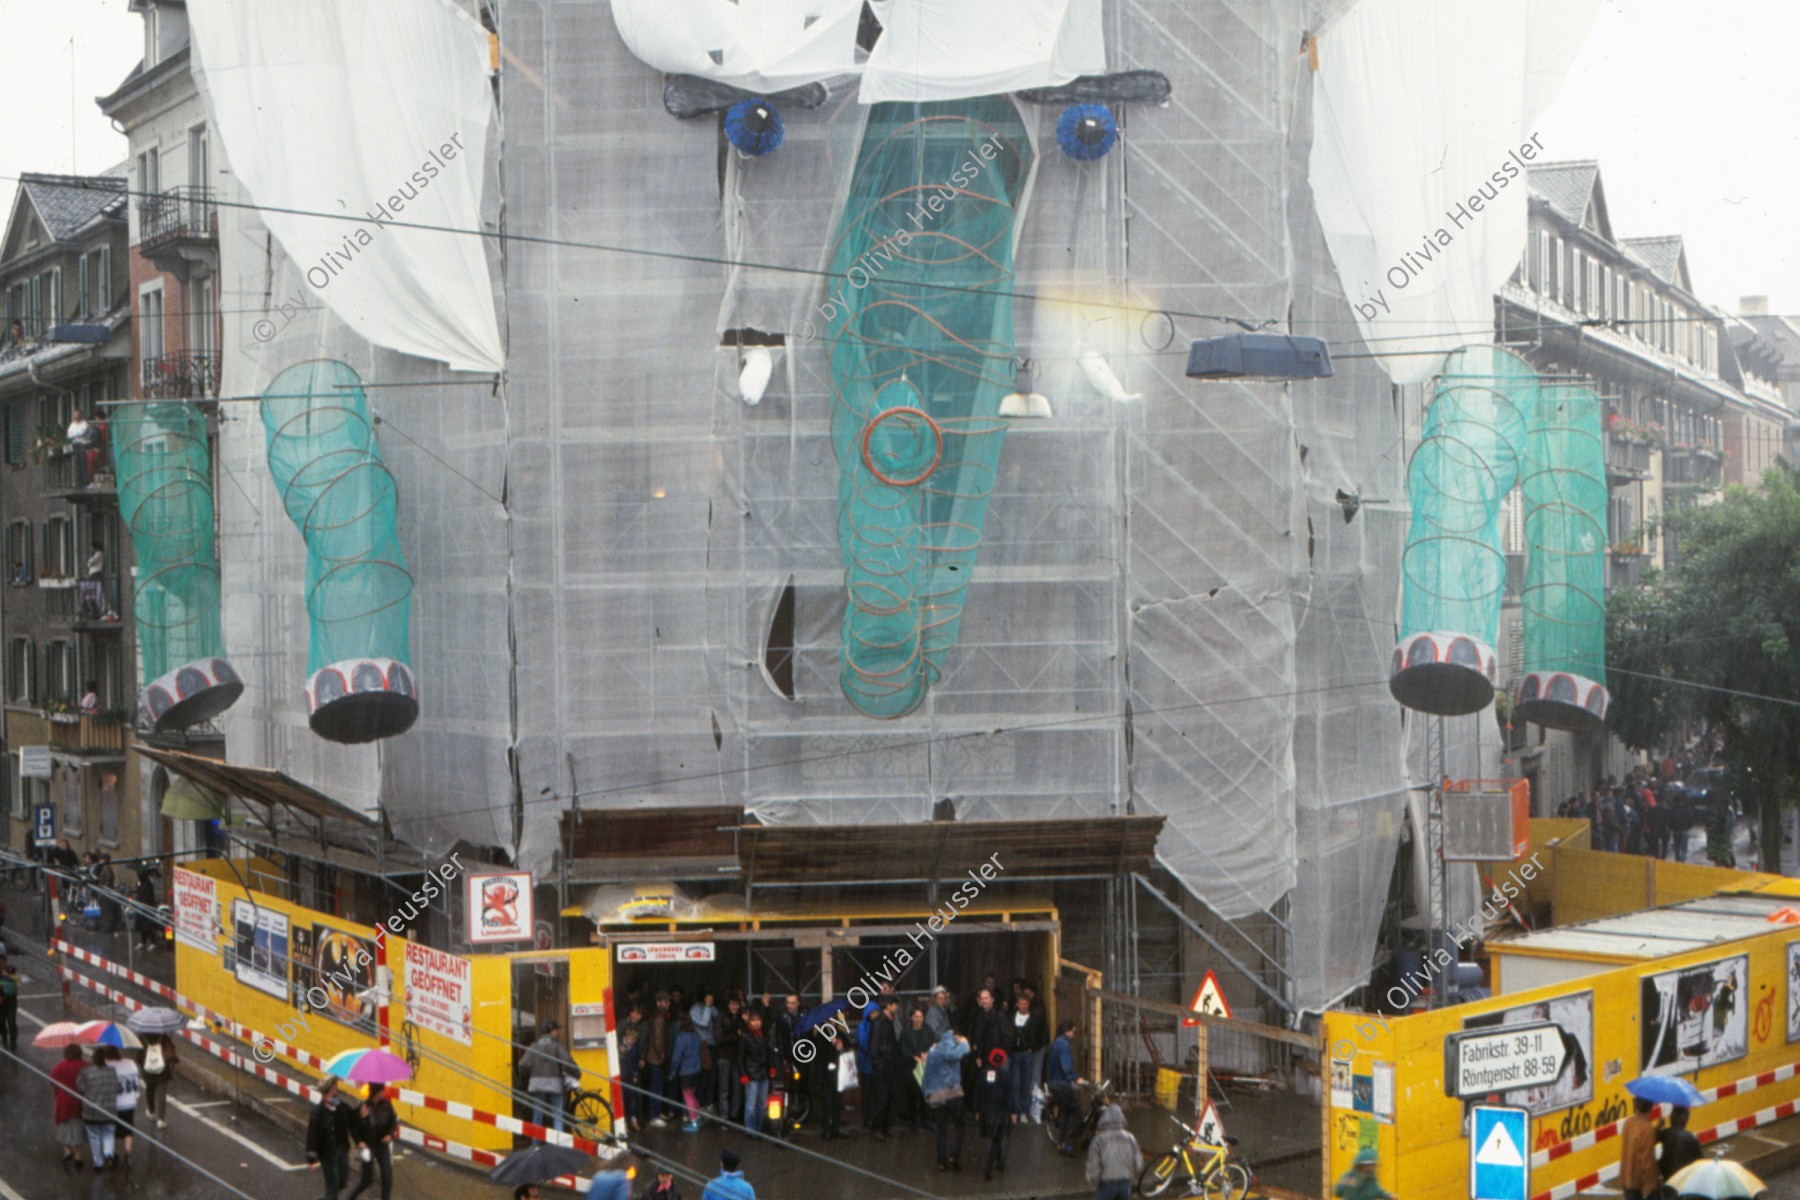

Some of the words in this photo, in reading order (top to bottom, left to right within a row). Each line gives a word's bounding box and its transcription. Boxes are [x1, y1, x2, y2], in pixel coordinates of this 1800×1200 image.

[40, 808, 51, 825] P
[405, 943, 468, 979] RESTAURANT
[1462, 1040, 1511, 1064] Fabrikstr.
[1514, 1034, 1543, 1056] 39-11
[1462, 1063, 1522, 1088] Röntgenstr.
[1524, 1055, 1556, 1078] 88-59
